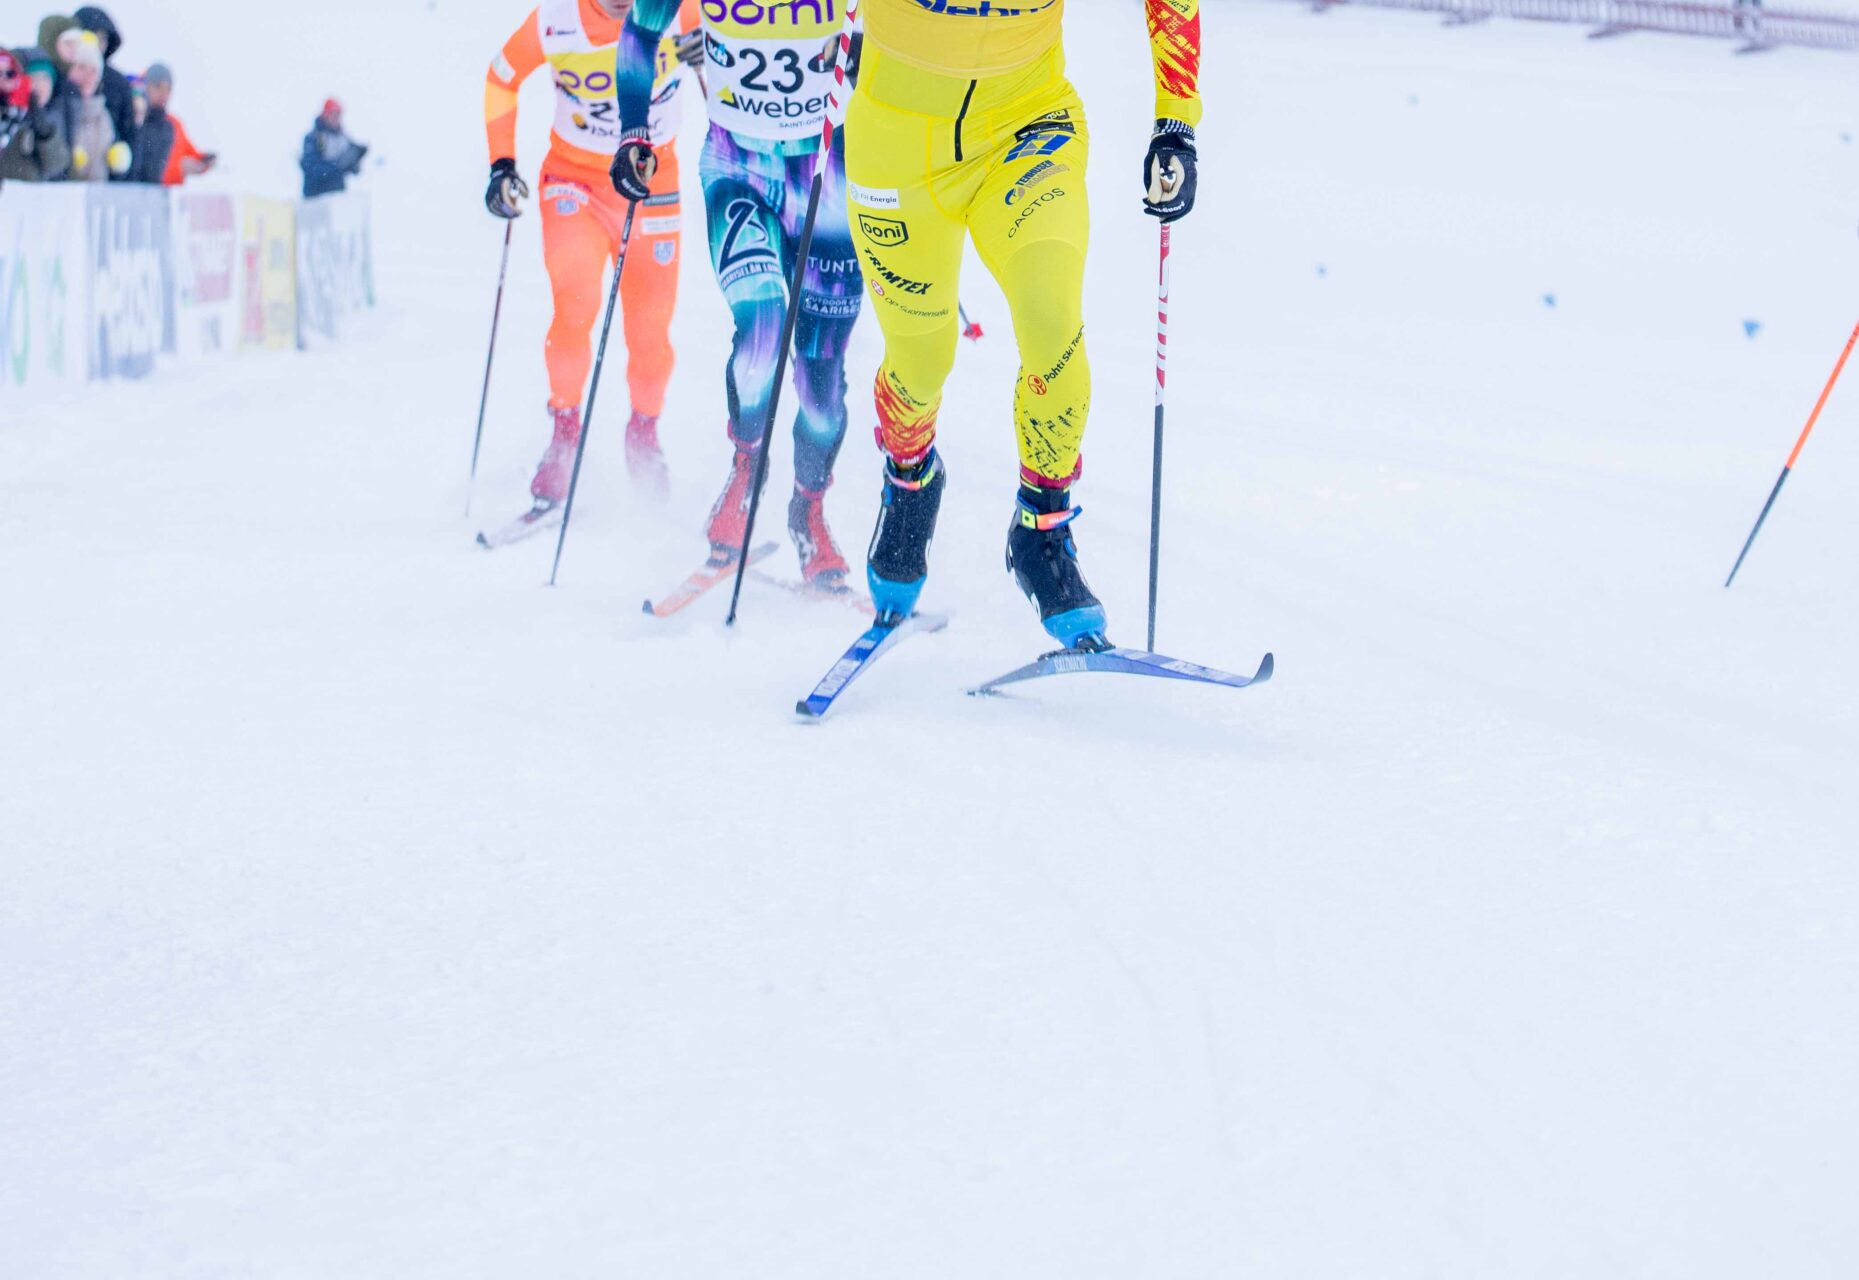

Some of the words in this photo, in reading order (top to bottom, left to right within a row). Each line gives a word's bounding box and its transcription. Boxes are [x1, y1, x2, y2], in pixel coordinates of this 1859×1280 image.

[559, 52, 667, 92] ooi
[739, 48, 804, 94] 23
[779, 114, 826, 128] SAINT-GOB
[870, 195, 897, 204] Energia
[1008, 188, 1065, 238] CACTOS
[807, 256, 857, 273] TUNT
[864, 247, 933, 295] TRIMTEX
[1043, 359, 1065, 383] Pohti
[1062, 345, 1074, 362] Ski
